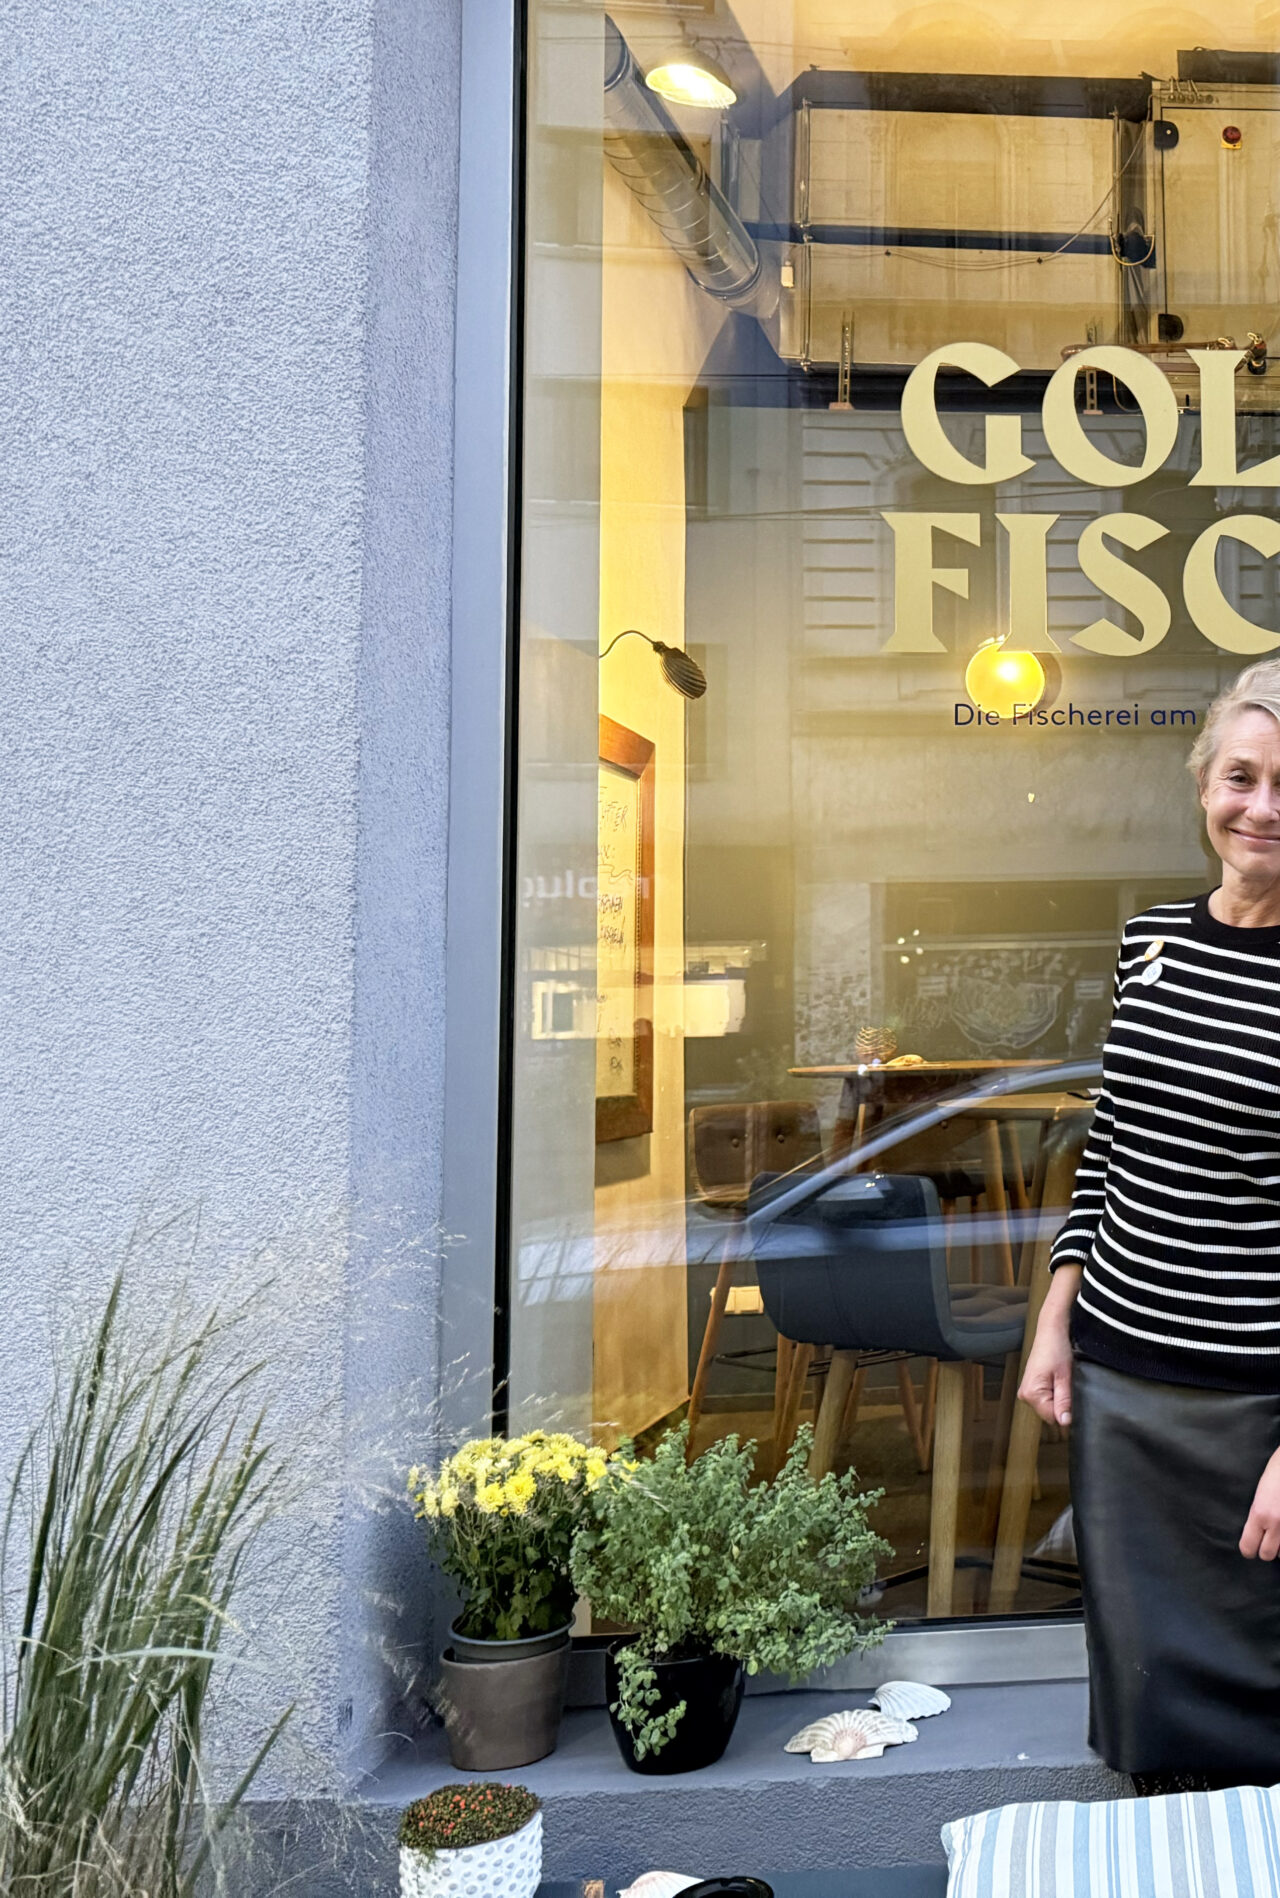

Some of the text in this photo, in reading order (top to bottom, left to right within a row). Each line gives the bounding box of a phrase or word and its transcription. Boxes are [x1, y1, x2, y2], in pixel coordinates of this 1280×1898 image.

[953, 703, 1196, 726] Die Fischerei am
